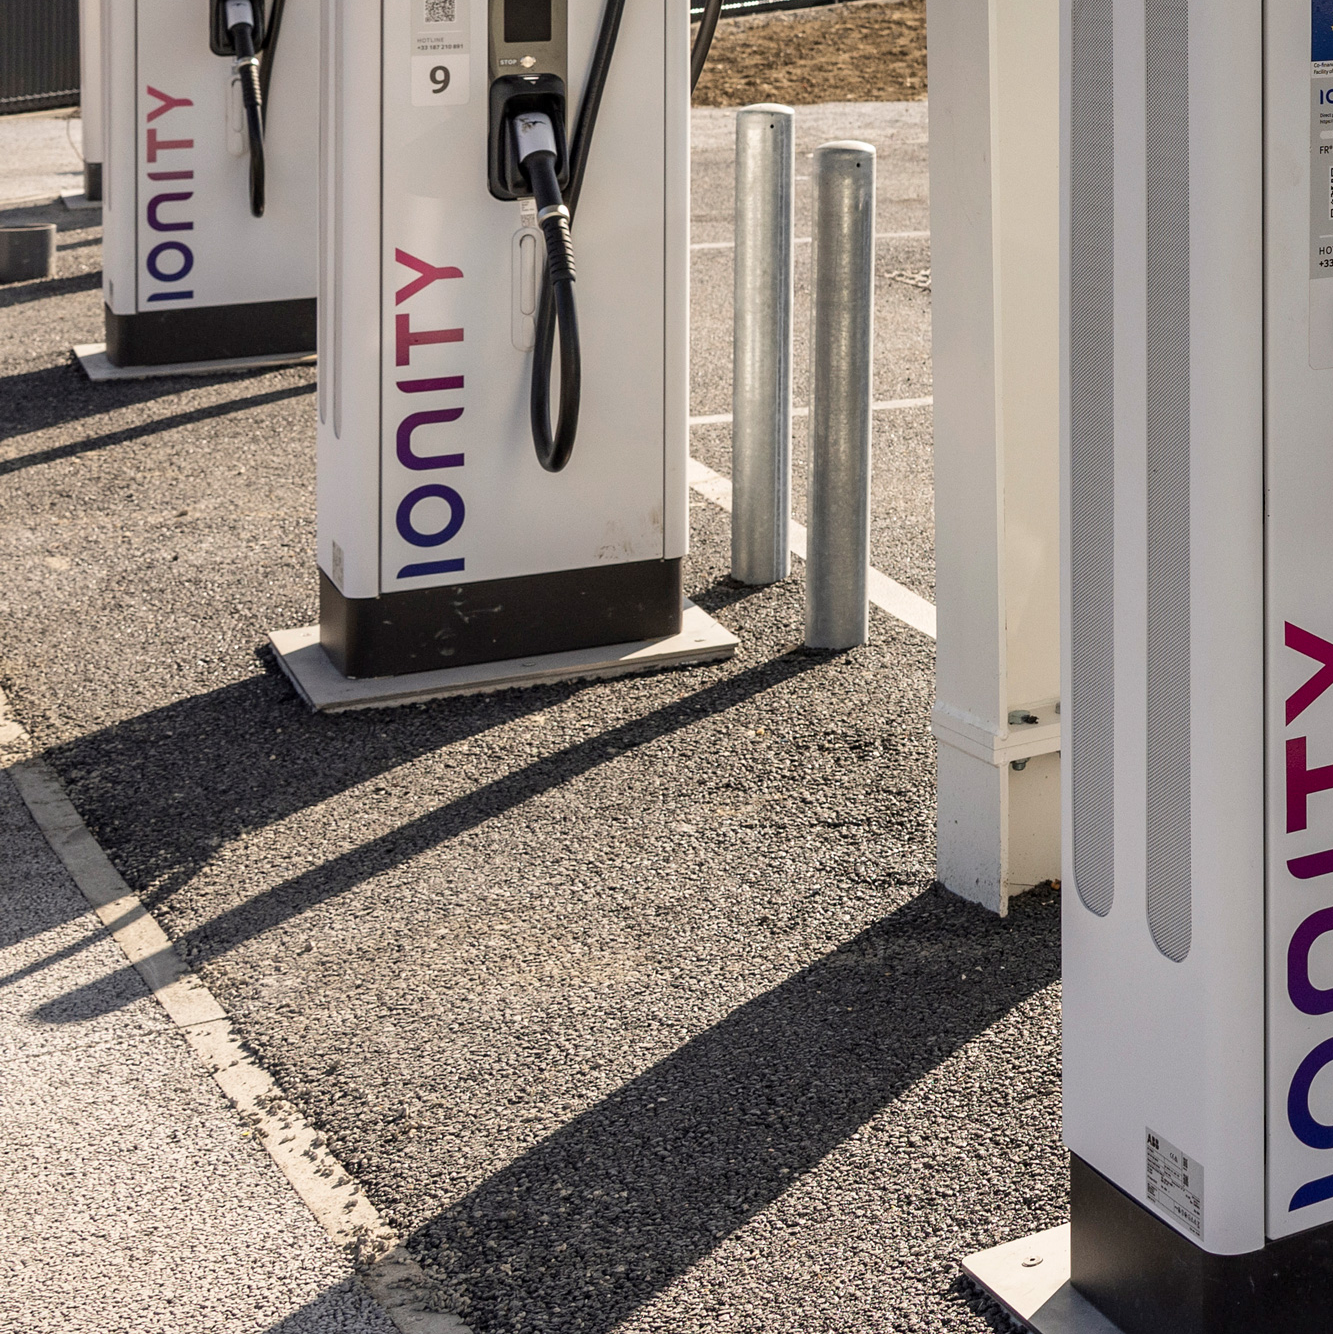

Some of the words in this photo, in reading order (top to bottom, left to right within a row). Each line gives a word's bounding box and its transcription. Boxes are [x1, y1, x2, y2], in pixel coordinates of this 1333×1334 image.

[429, 65, 451, 94] 9
[146, 85, 194, 302] IONITY
[394, 247, 466, 579] IONITY
